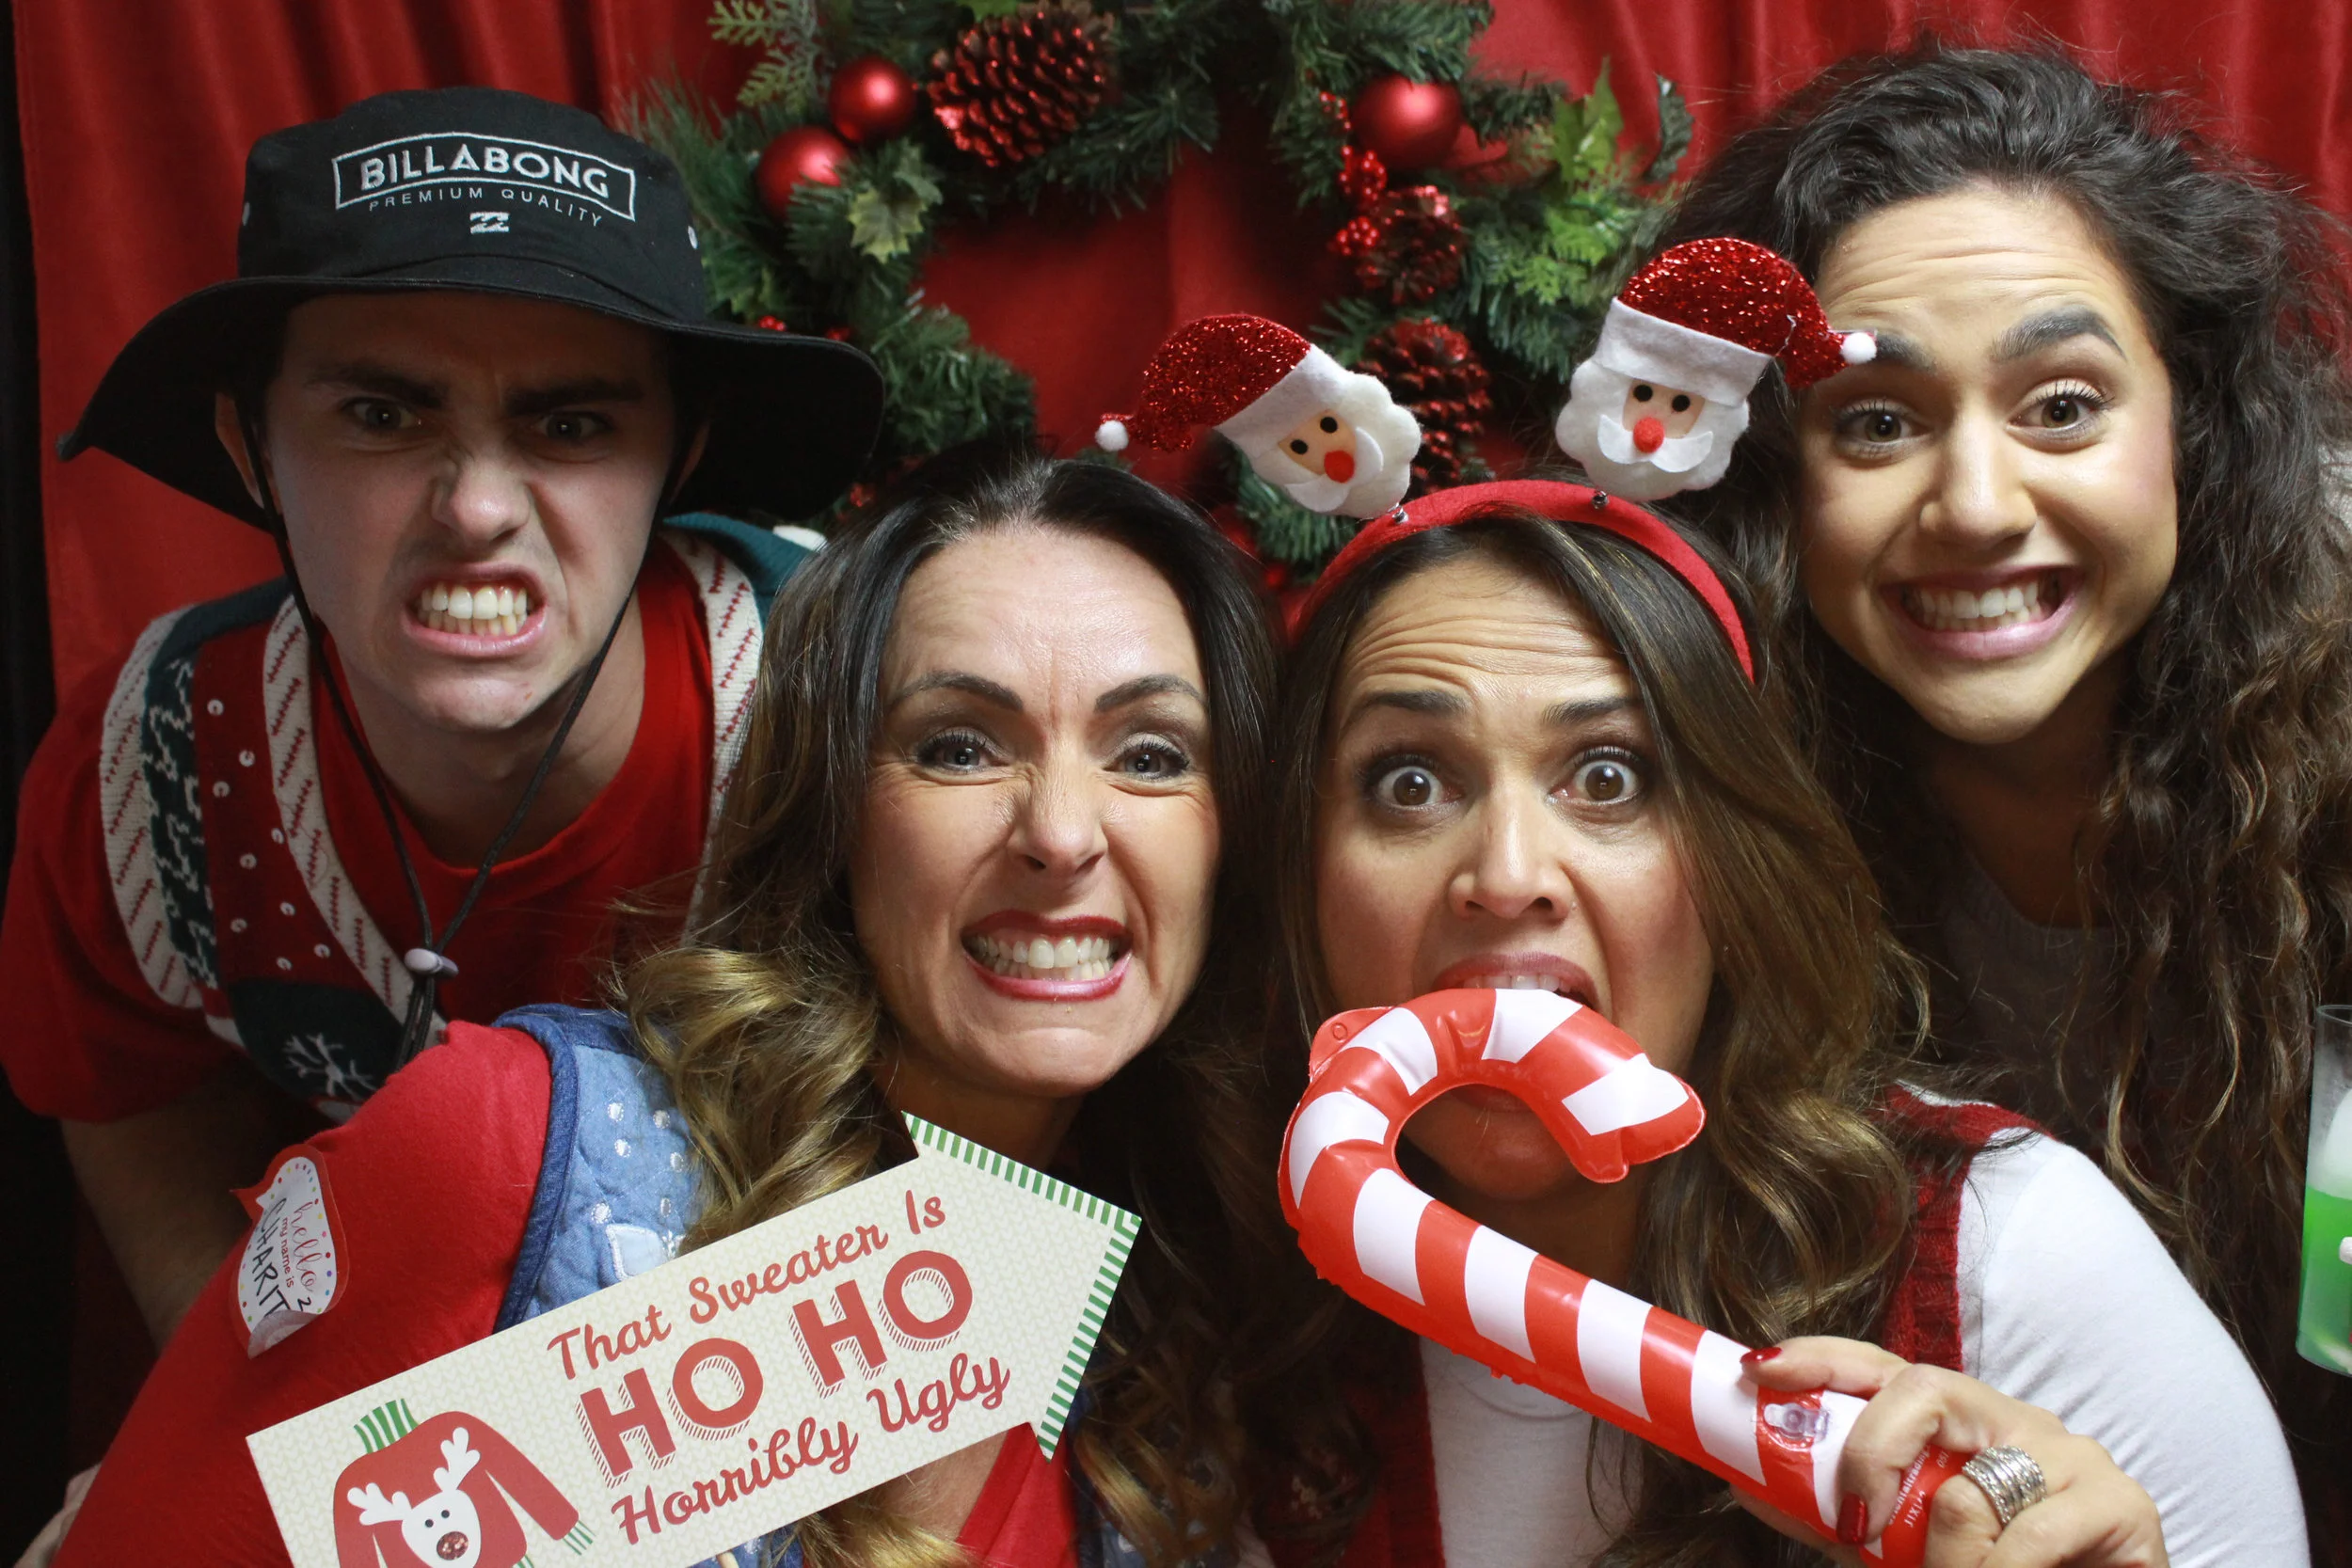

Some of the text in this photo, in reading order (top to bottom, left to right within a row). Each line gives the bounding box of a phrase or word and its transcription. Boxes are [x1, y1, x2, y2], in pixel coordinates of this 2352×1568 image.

[360, 143, 610, 198] BILLABONG
[369, 187, 603, 228] PREMIUM QUALITY
[279, 1217, 294, 1289] my name is
[290, 1201, 323, 1292] hello
[547, 1189, 946, 1381] That Sweater Is
[576, 1249, 974, 1490] HO HO
[612, 1352, 1011, 1544] Horribly Ugly
